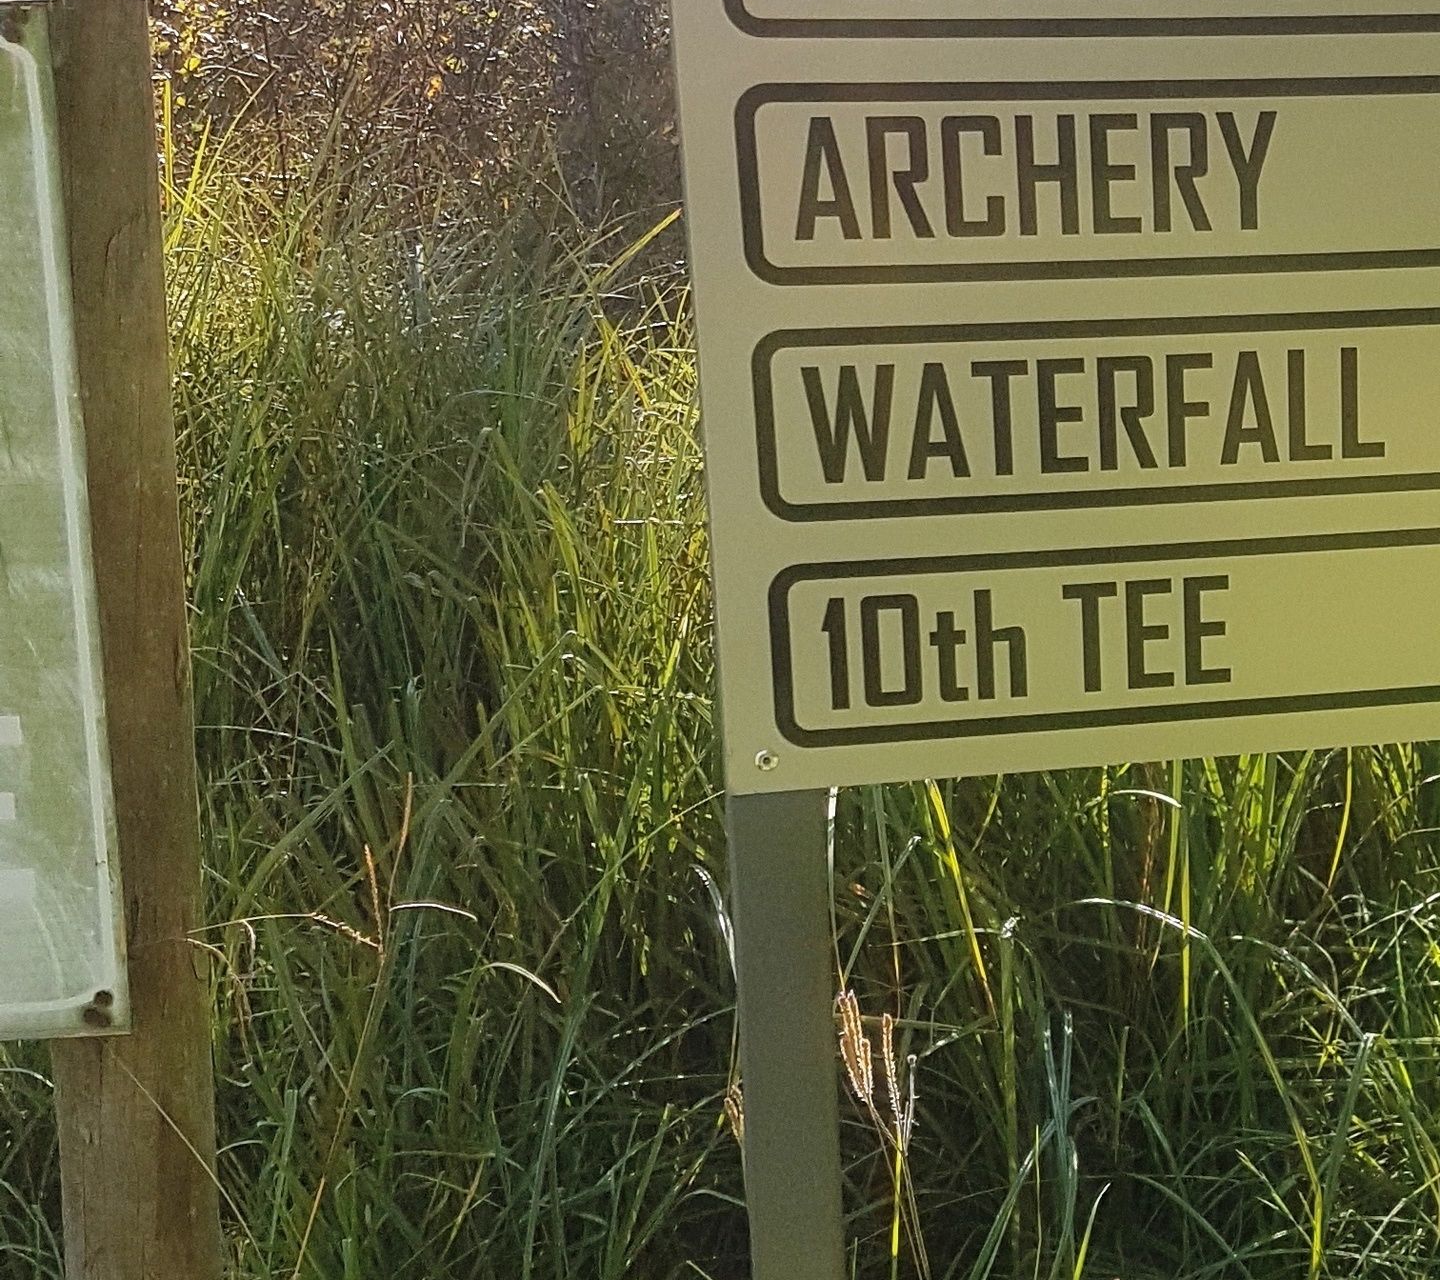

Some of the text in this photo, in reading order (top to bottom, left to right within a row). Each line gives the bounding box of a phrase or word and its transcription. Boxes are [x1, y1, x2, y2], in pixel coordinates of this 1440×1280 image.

[795, 110, 1277, 240] ARCHERY
[801, 347, 1386, 482] WATERFALL
[821, 575, 1231, 710] 10th TEE
